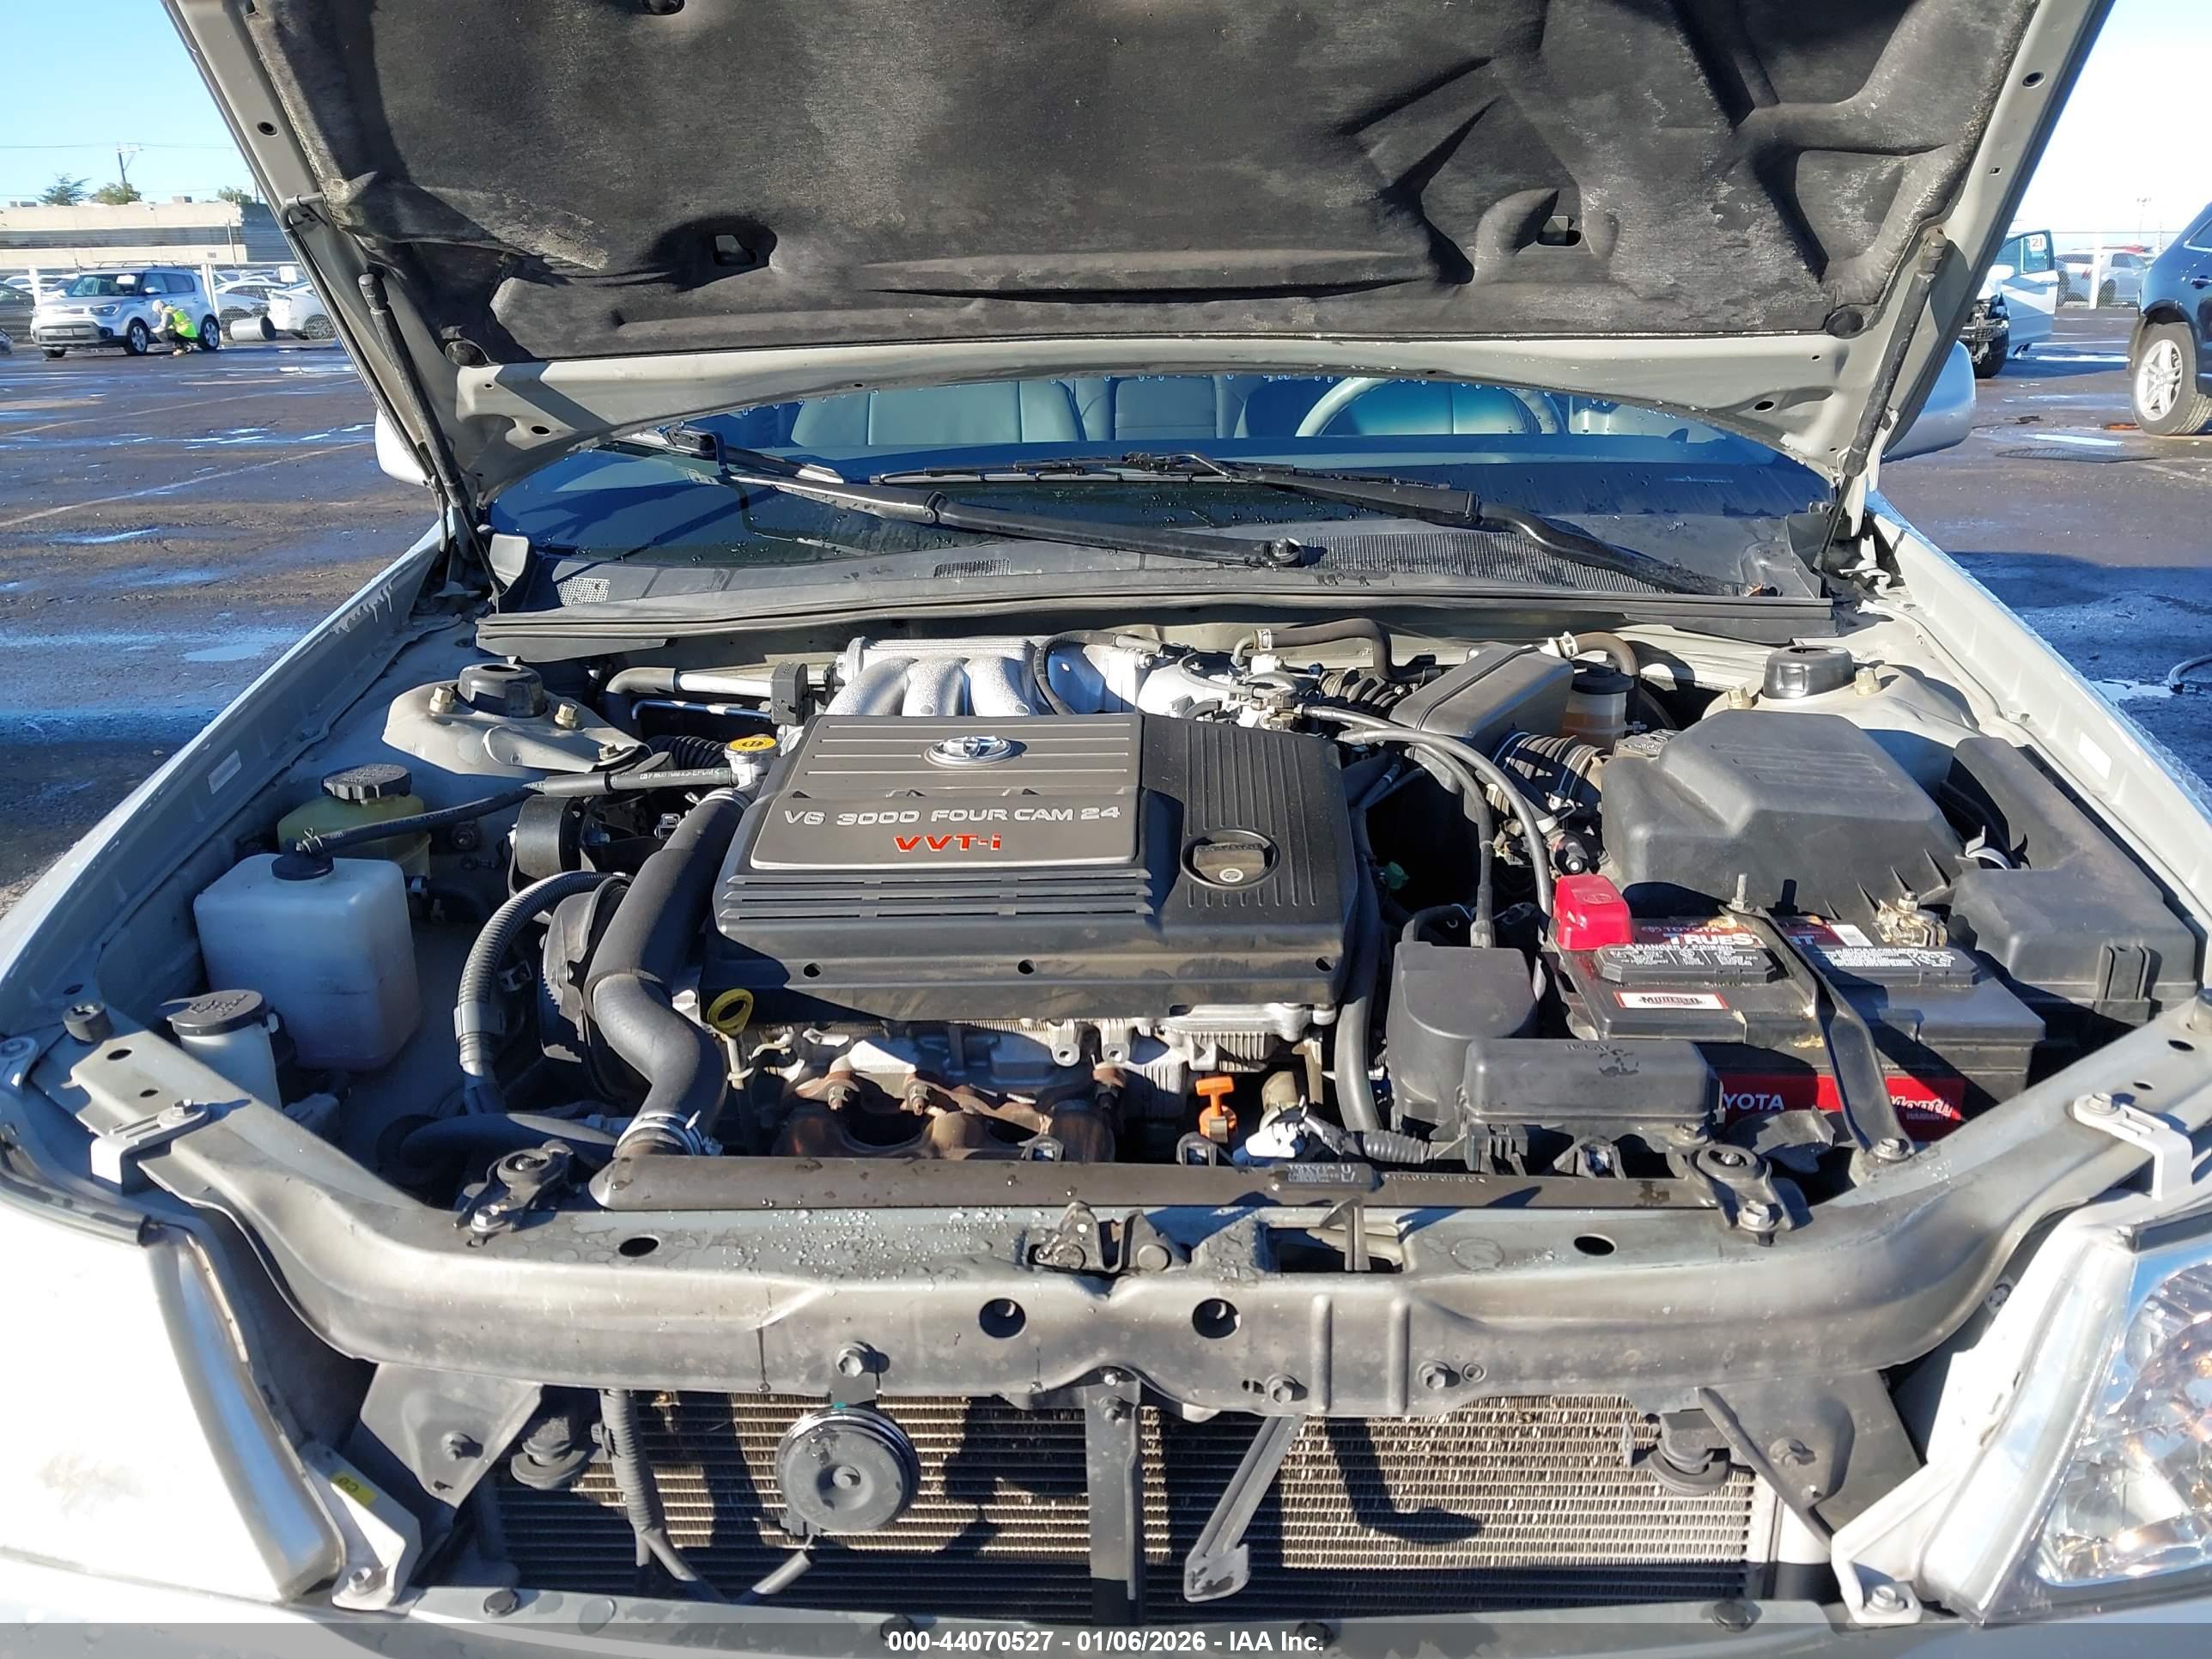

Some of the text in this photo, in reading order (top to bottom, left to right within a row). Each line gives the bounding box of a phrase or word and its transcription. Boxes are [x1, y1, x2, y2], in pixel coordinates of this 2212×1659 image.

[784, 806, 1121, 826] V6 3000 FOUR CAM 24
[893, 833, 1003, 853] VVT-i
[1723, 1094, 1785, 1111] YOTA
